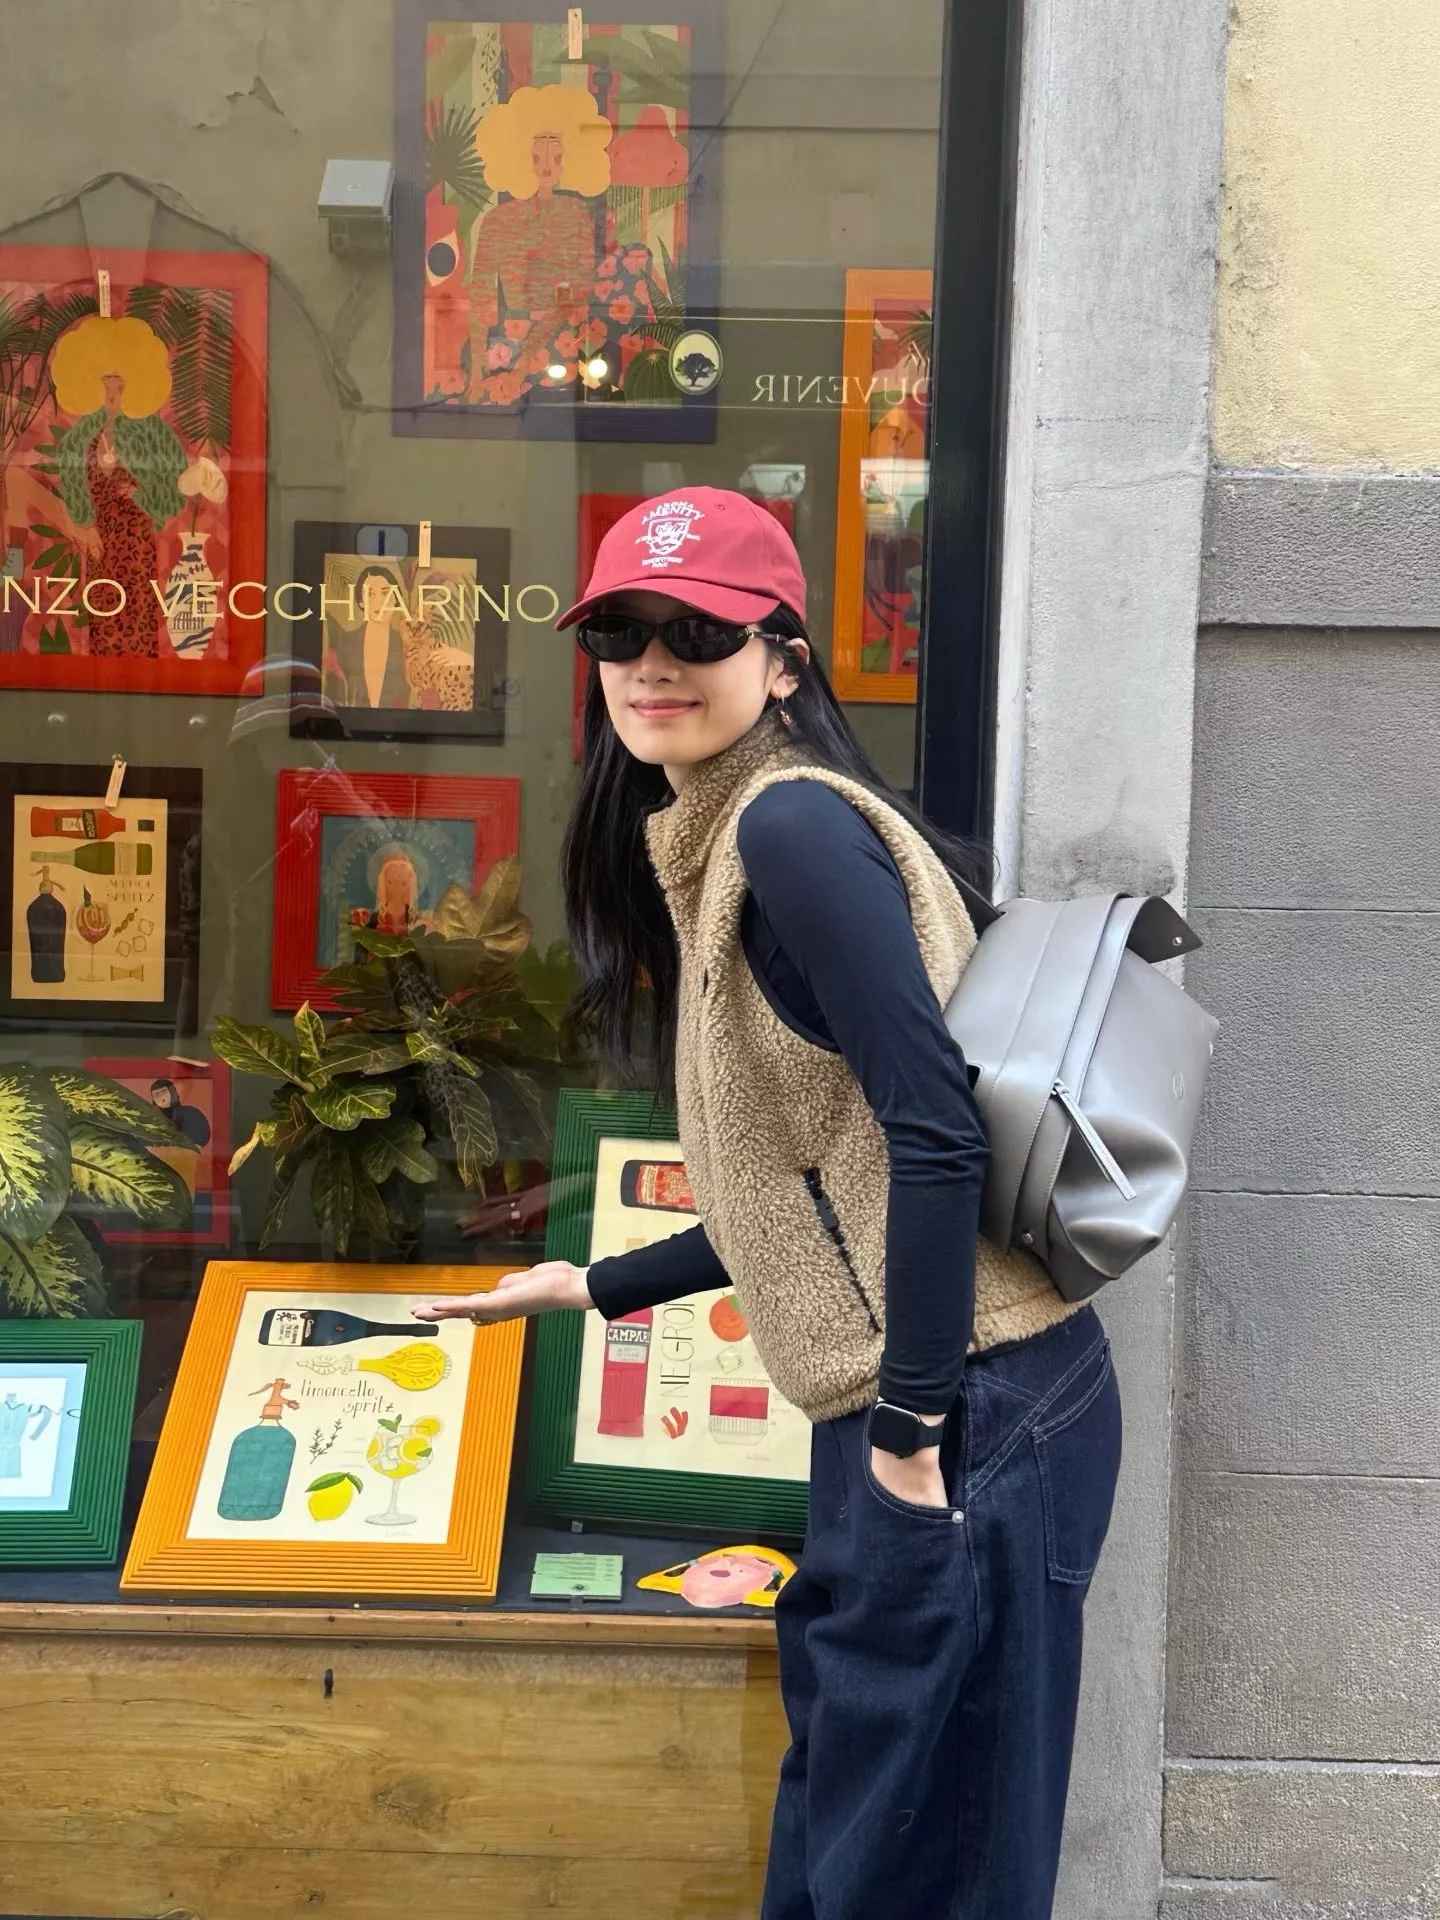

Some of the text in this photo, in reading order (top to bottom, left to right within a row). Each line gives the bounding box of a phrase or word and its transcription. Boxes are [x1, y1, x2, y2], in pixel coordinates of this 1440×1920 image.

[3, 575, 560, 623] NZO VECCHIARINO
[300, 1379, 375, 1397] limoncello
[342, 1395, 395, 1419] spritz
